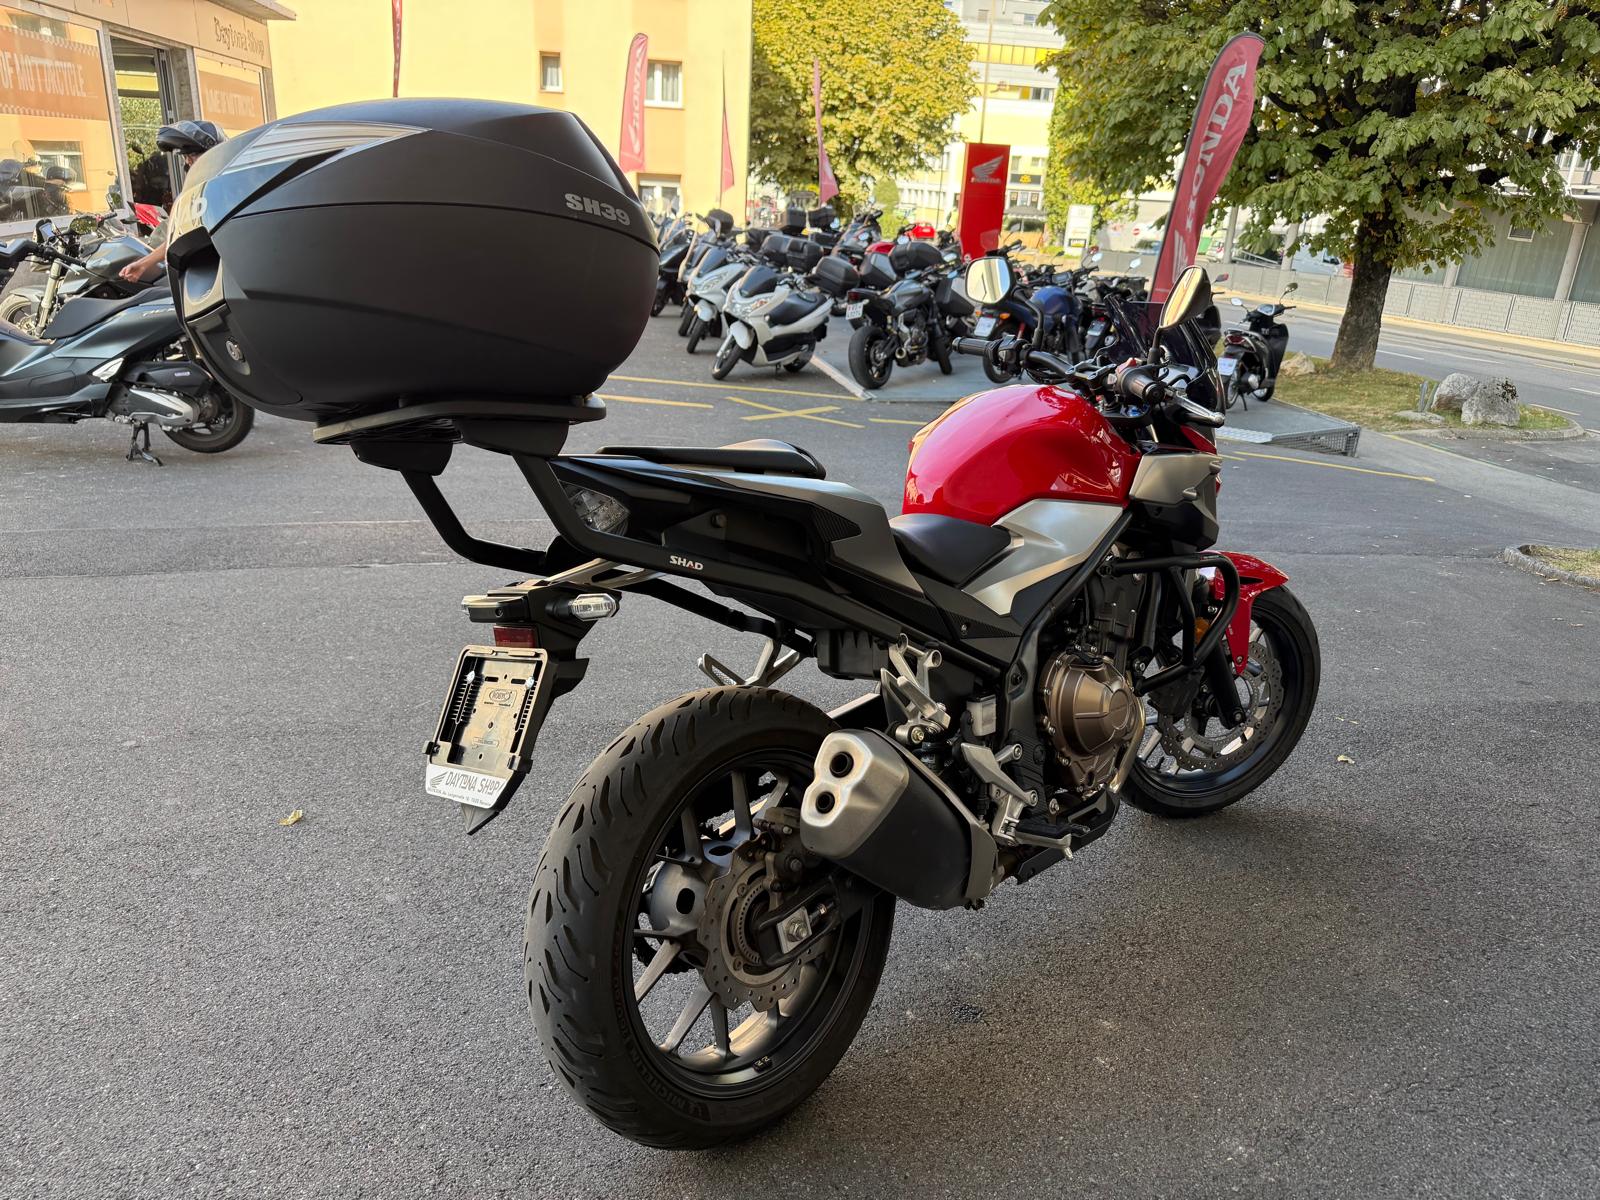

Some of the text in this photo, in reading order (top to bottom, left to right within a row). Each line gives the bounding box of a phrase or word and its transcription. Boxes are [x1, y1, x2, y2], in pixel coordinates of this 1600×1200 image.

[1186, 61, 1248, 232] HONDA
[564, 193, 630, 226] SH39
[669, 555, 704, 570] SHAD
[445, 771, 500, 796] DAYTONA SHOP
[629, 1045, 686, 1111] MICHELIN
